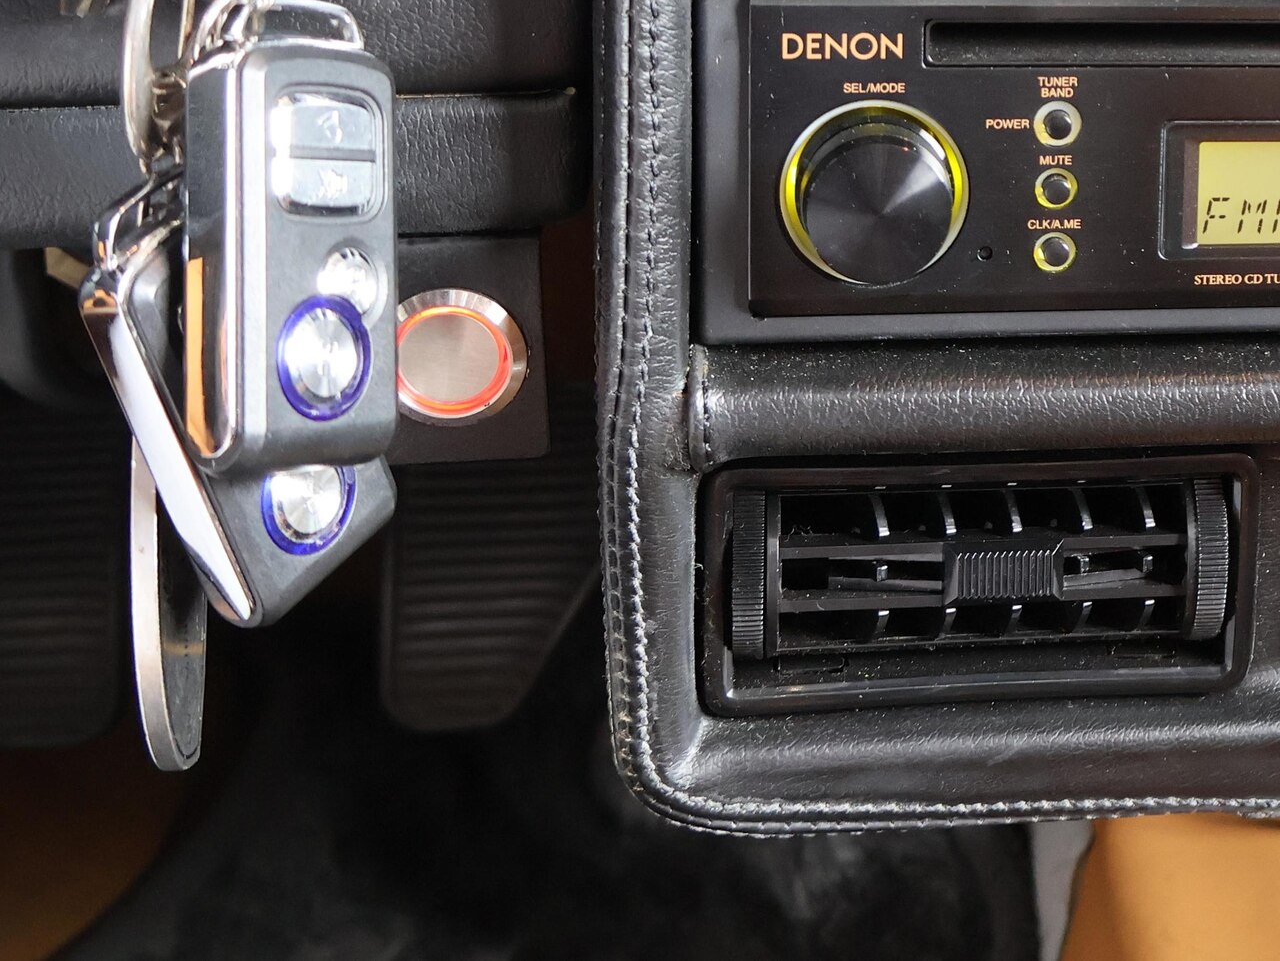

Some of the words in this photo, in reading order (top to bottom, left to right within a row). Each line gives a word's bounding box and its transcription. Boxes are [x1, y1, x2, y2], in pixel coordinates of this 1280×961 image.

[781, 32, 904, 60] DENON
[1037, 76, 1078, 87] TUNER
[843, 82, 906, 94] SEL/MODE
[1040, 87, 1074, 98] BAND
[985, 119, 1030, 130] POWER
[1039, 155, 1073, 166] MUTE
[1027, 219, 1082, 230] CLK/A.ME
[1194, 274, 1243, 286] STEREO
[1244, 274, 1263, 285] CD
